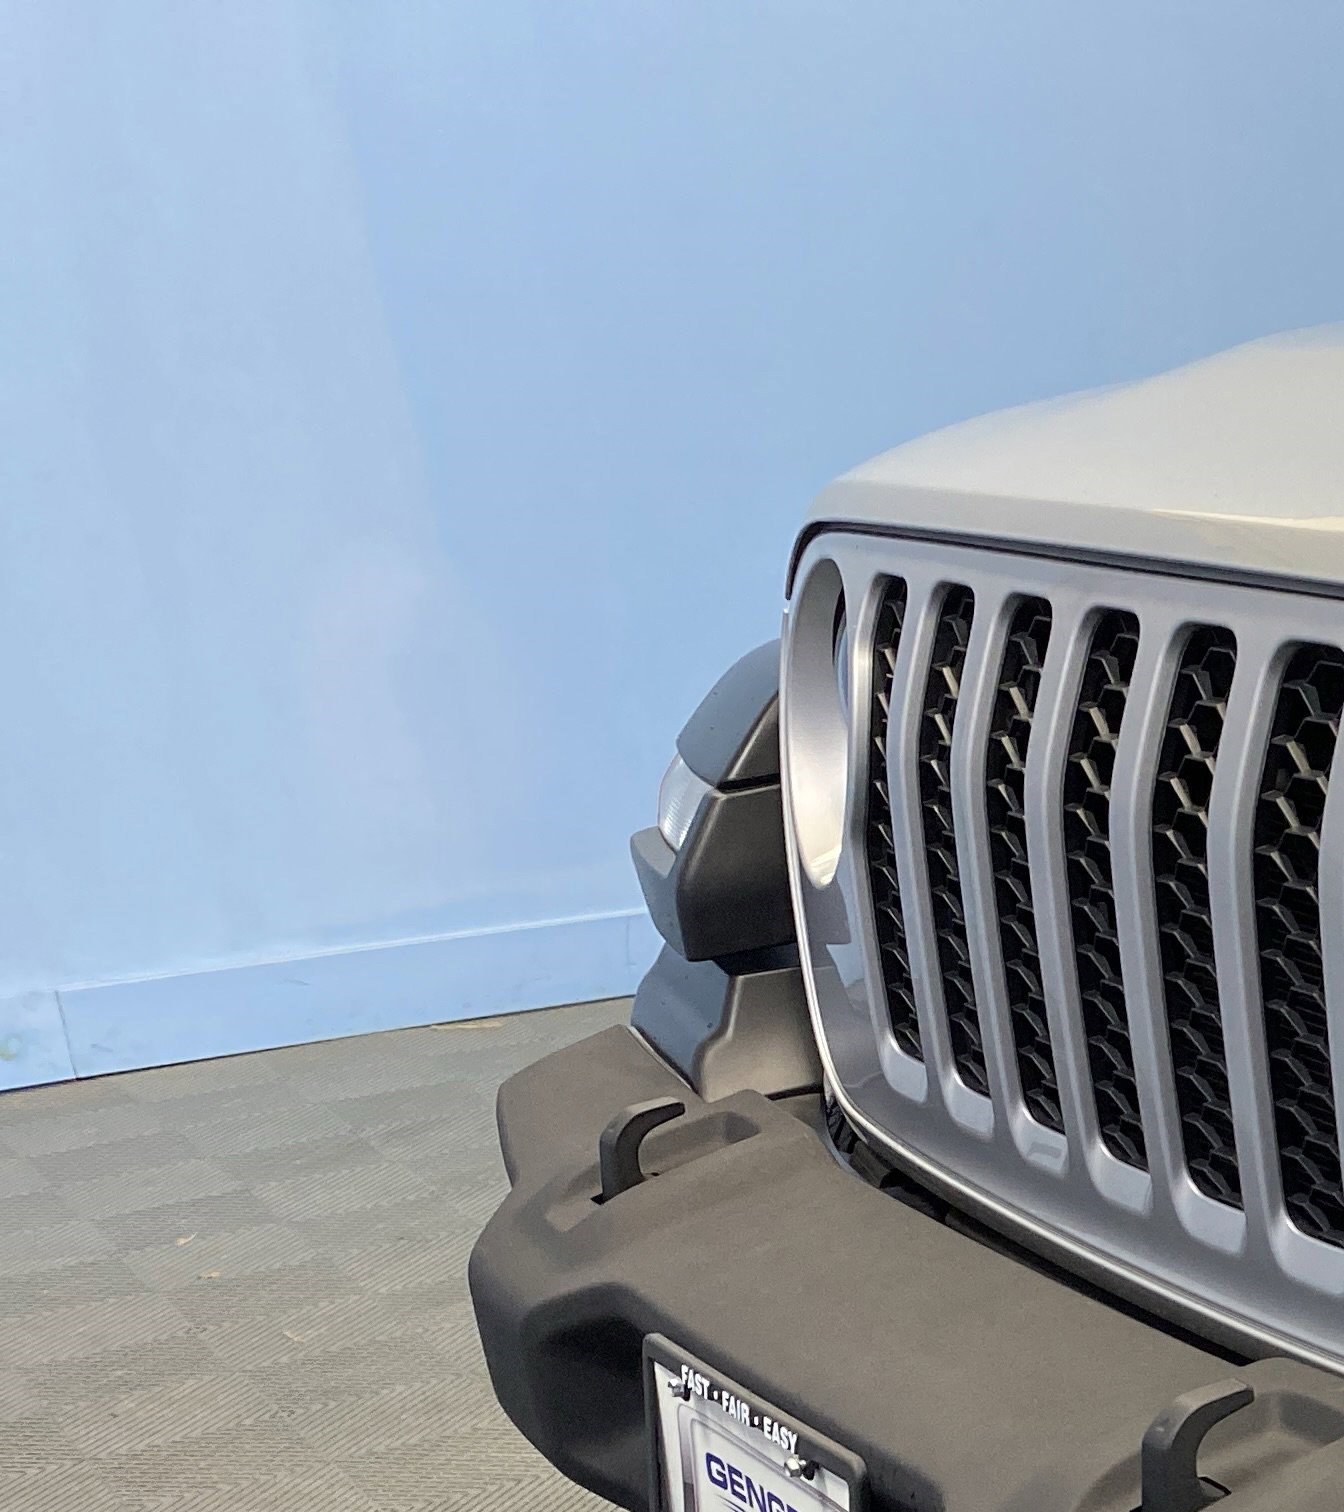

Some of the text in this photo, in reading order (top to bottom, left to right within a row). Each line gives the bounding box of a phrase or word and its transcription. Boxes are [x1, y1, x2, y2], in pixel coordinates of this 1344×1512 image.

[681, 1364, 798, 1454] FAST FAIR EASY
